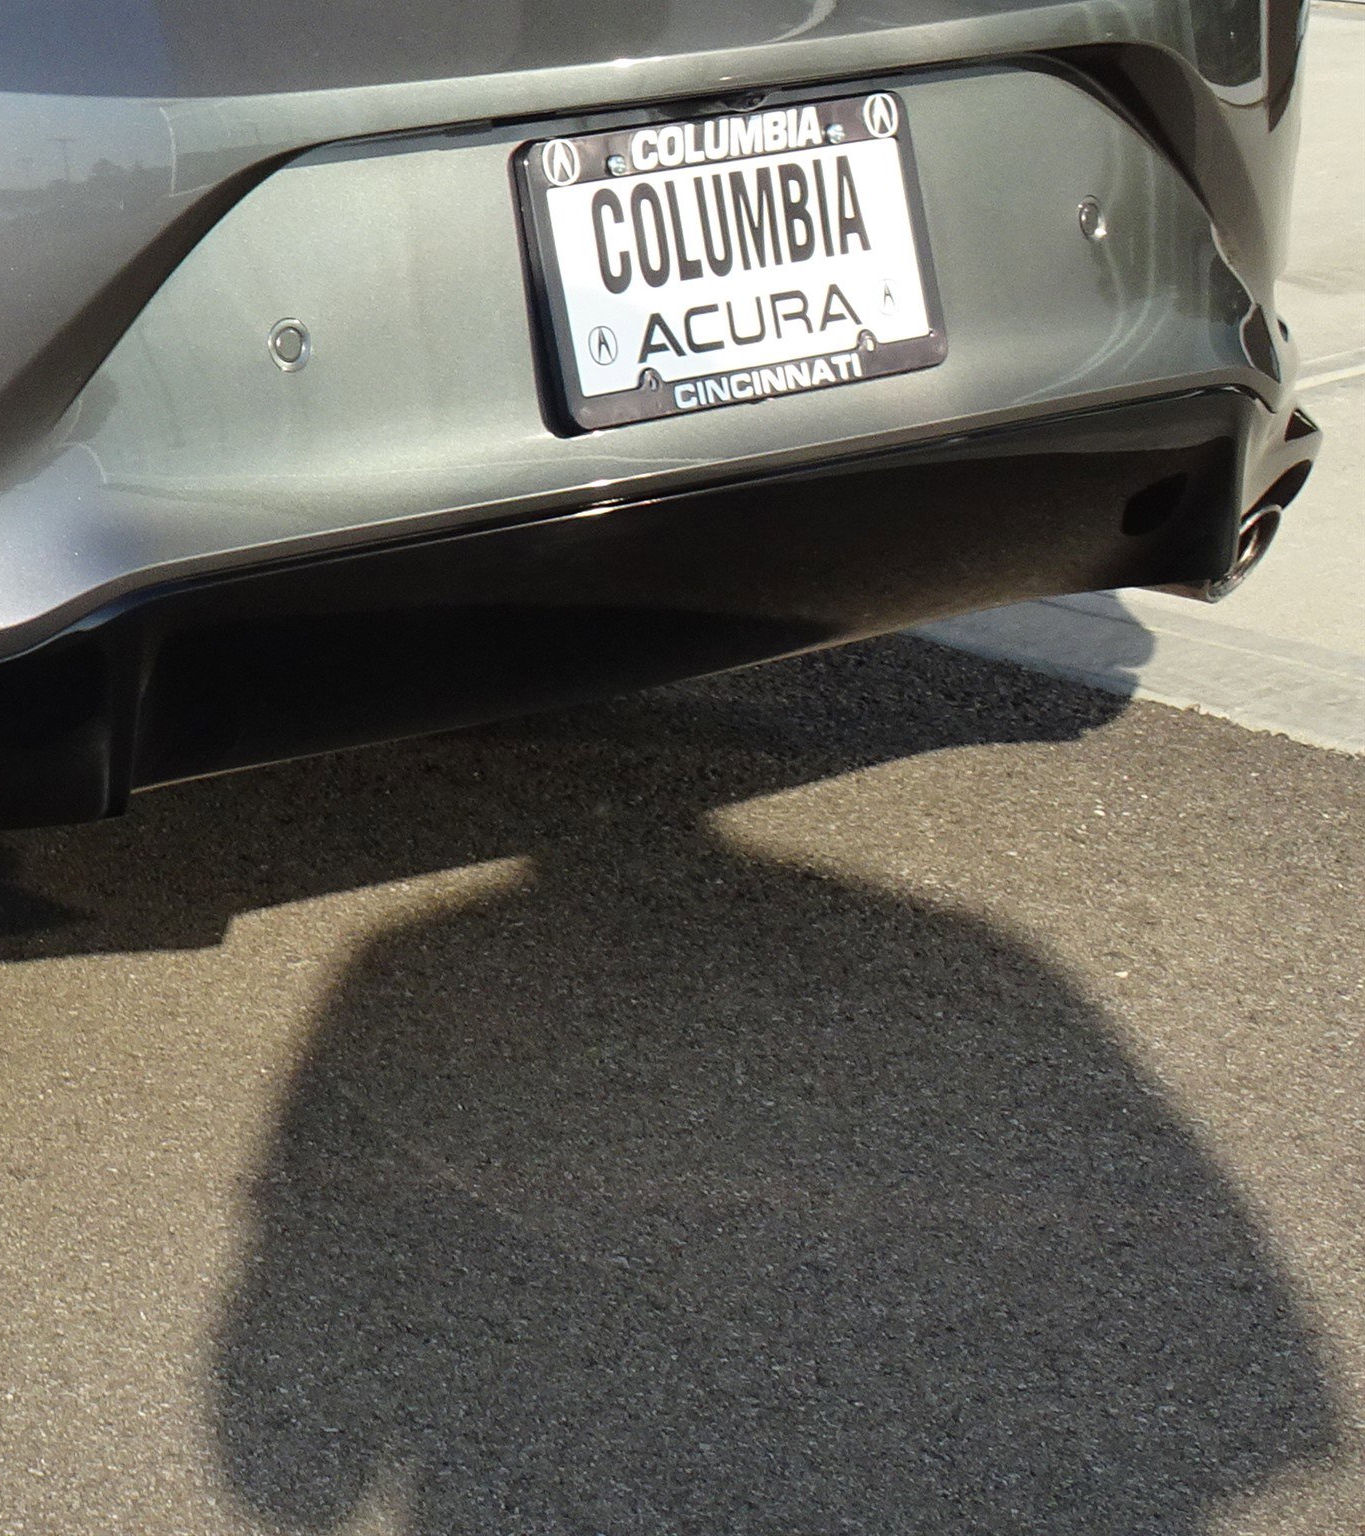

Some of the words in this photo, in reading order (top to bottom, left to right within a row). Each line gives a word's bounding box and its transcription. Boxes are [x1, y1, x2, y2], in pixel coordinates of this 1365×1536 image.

[631, 107, 822, 170] COLUMBIA
[591, 155, 872, 295] COLUMBIA
[637, 284, 863, 364] ACURA
[674, 354, 862, 410] CINCINNATI
